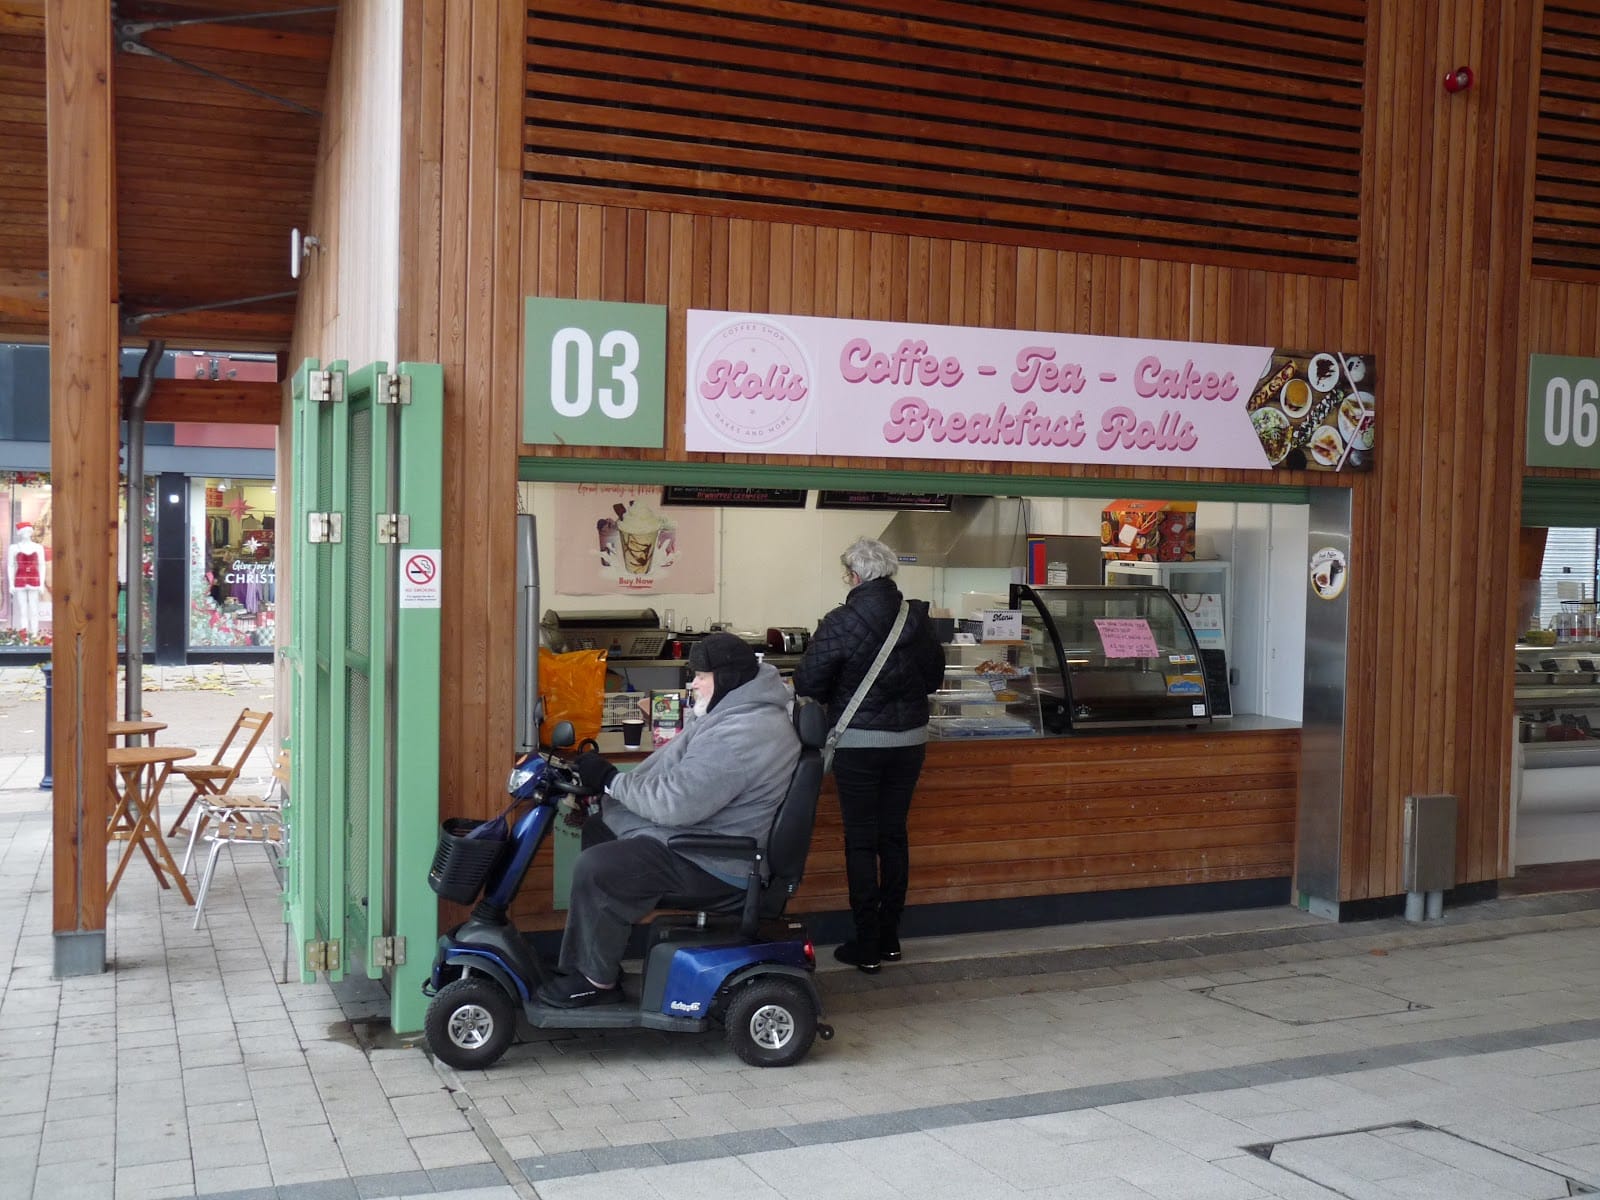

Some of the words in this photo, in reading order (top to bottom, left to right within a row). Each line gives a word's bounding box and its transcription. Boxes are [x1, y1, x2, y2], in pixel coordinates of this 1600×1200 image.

[722, 324, 757, 338] COFFEE
[762, 326, 785, 341] SHOP
[550, 326, 640, 419] 03
[700, 359, 807, 401] Kolis
[840, 337, 964, 386] Coffee
[1011, 346, 1086, 394] Tea
[1133, 355, 1240, 401] Cakes
[768, 415, 791, 434] MORE
[883, 396, 1087, 449] Breakfast
[1096, 405, 1199, 451] Rolls
[1544, 376, 1599, 447] 06
[225, 573, 276, 584] CHRIST
[618, 576, 634, 586] Buy
[635, 577, 653, 585] Now
[992, 613, 1014, 622] Menu
